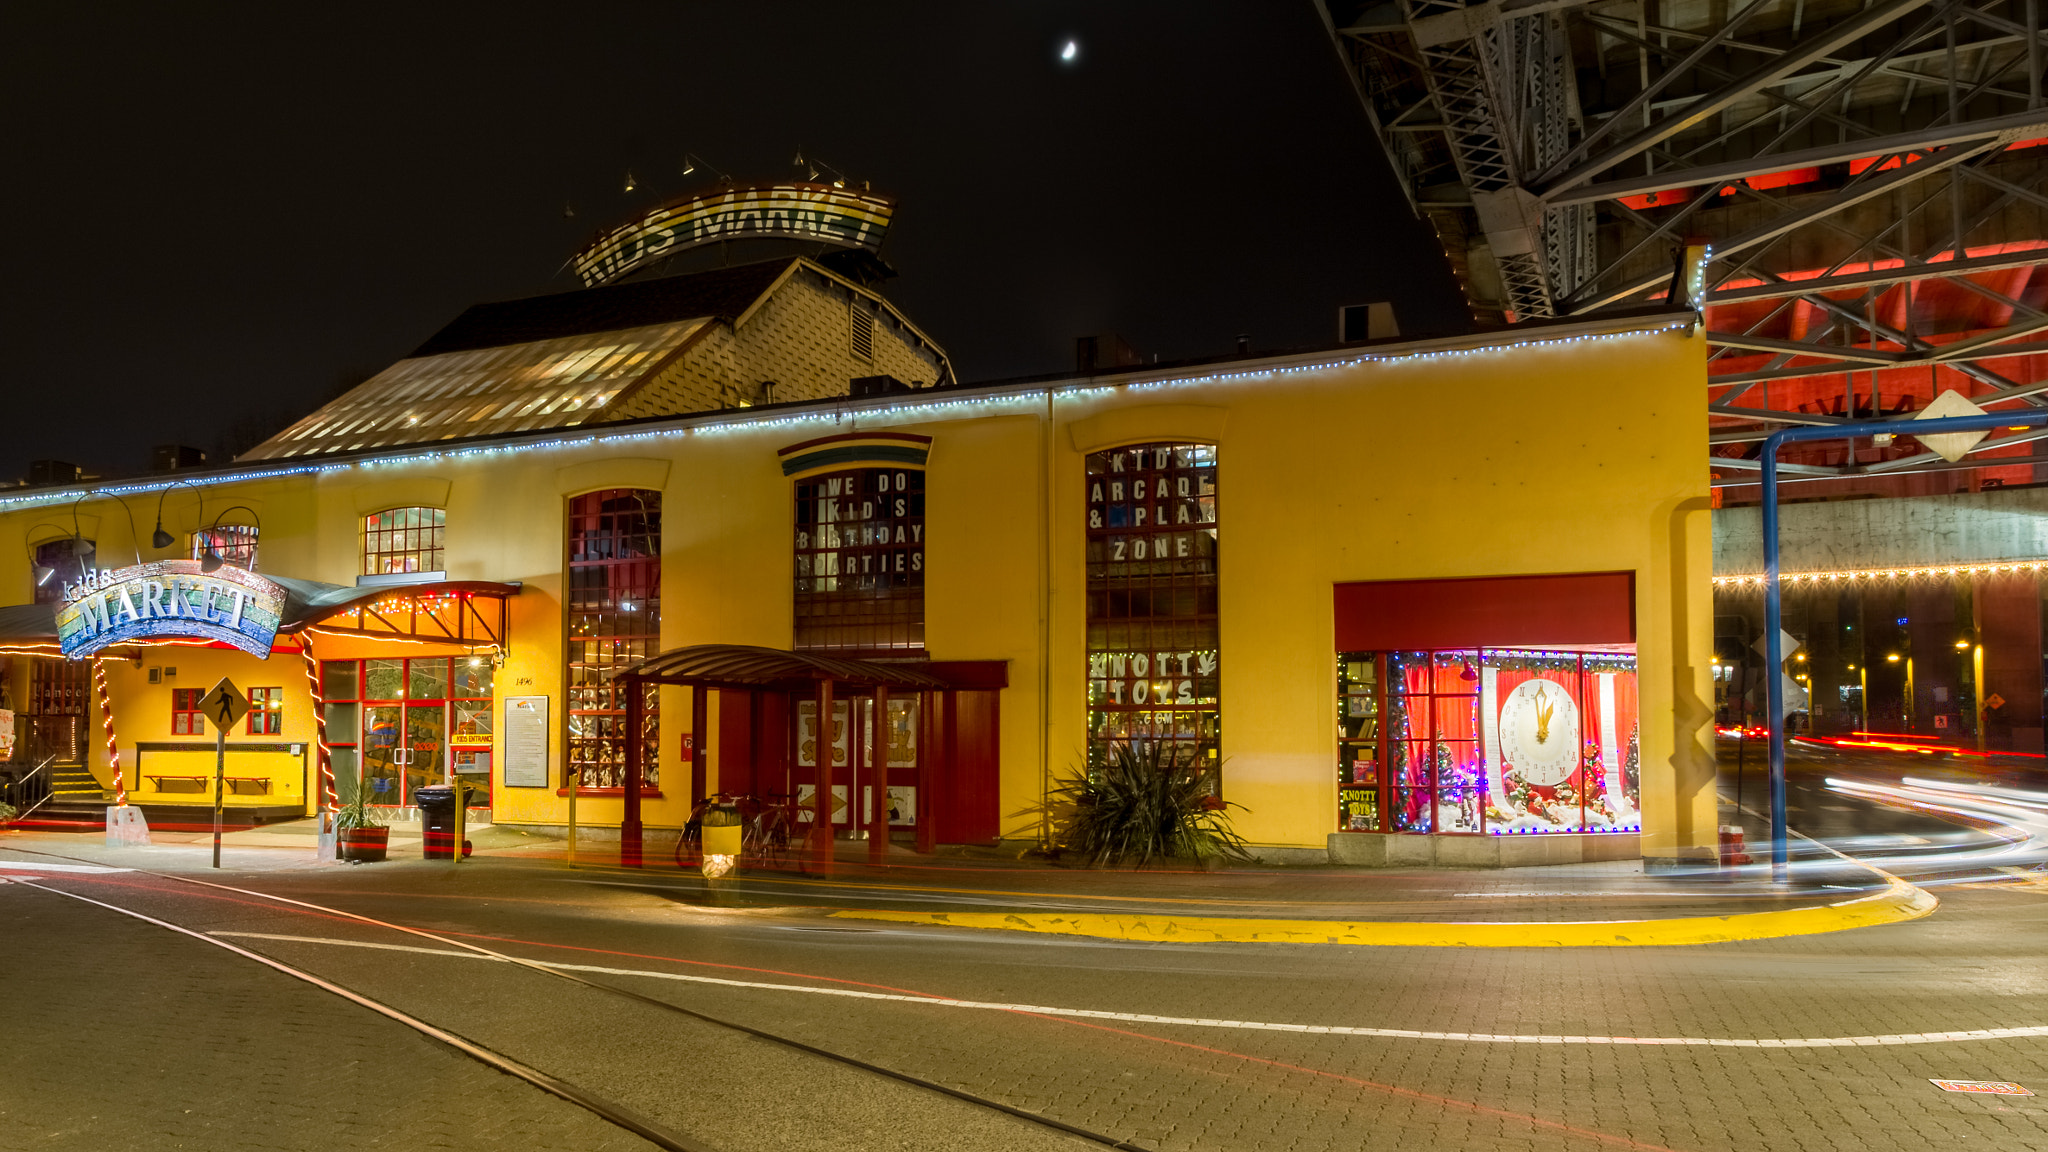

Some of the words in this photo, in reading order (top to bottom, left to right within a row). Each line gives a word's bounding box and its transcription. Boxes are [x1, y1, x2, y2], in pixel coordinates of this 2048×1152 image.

[576, 208, 675, 288] KIDS
[692, 185, 888, 247] MARKET
[1112, 448, 1188, 473] KIDS
[827, 477, 854, 496] WE
[878, 472, 906, 492] DO
[1091, 476, 1208, 502] ARCADE
[1089, 509, 1103, 529] &
[1134, 504, 1211, 527] PLAY
[1113, 538, 1188, 561] ZONE
[62, 568, 112, 601] kids
[77, 579, 256, 637] MARKET
[1090, 652, 1217, 678] KNOTTY
[515, 677, 533, 686] 1496
[1112, 680, 1193, 705] TOYS
[1342, 789, 1376, 802] KNOTTY
[1348, 803, 1371, 815] TOYS
